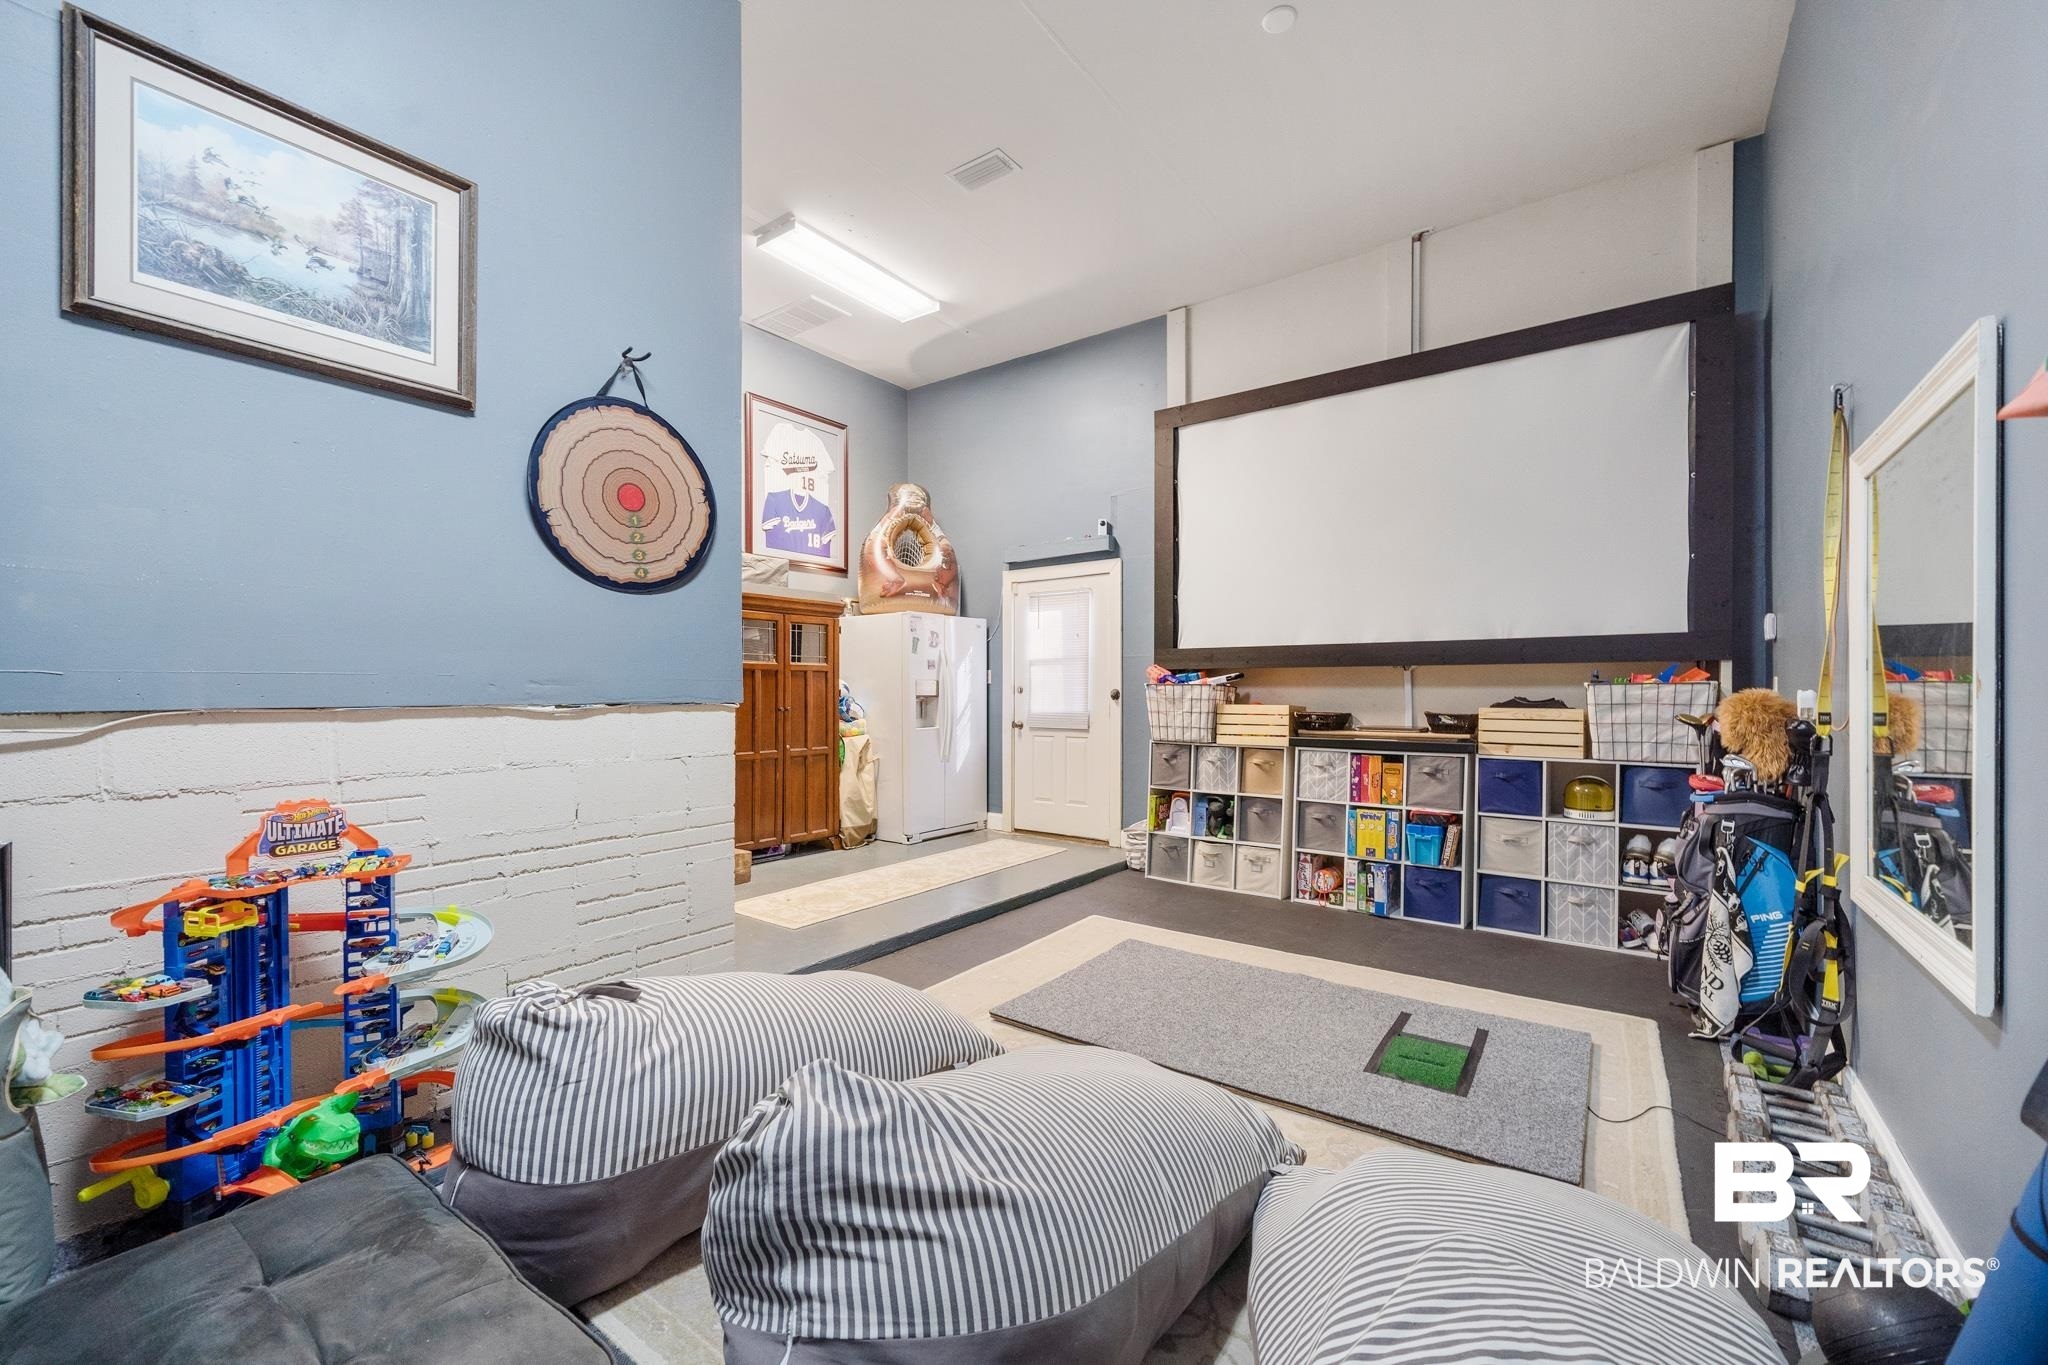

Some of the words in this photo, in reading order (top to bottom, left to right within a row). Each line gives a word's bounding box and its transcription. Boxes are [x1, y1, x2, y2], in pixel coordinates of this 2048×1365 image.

[801, 476, 815, 491] 18
[808, 533, 821, 548] 18
[267, 813, 344, 842] ULTIMATE
[274, 839, 338, 855] GARAGE
[1750, 911, 1784, 923] PING
